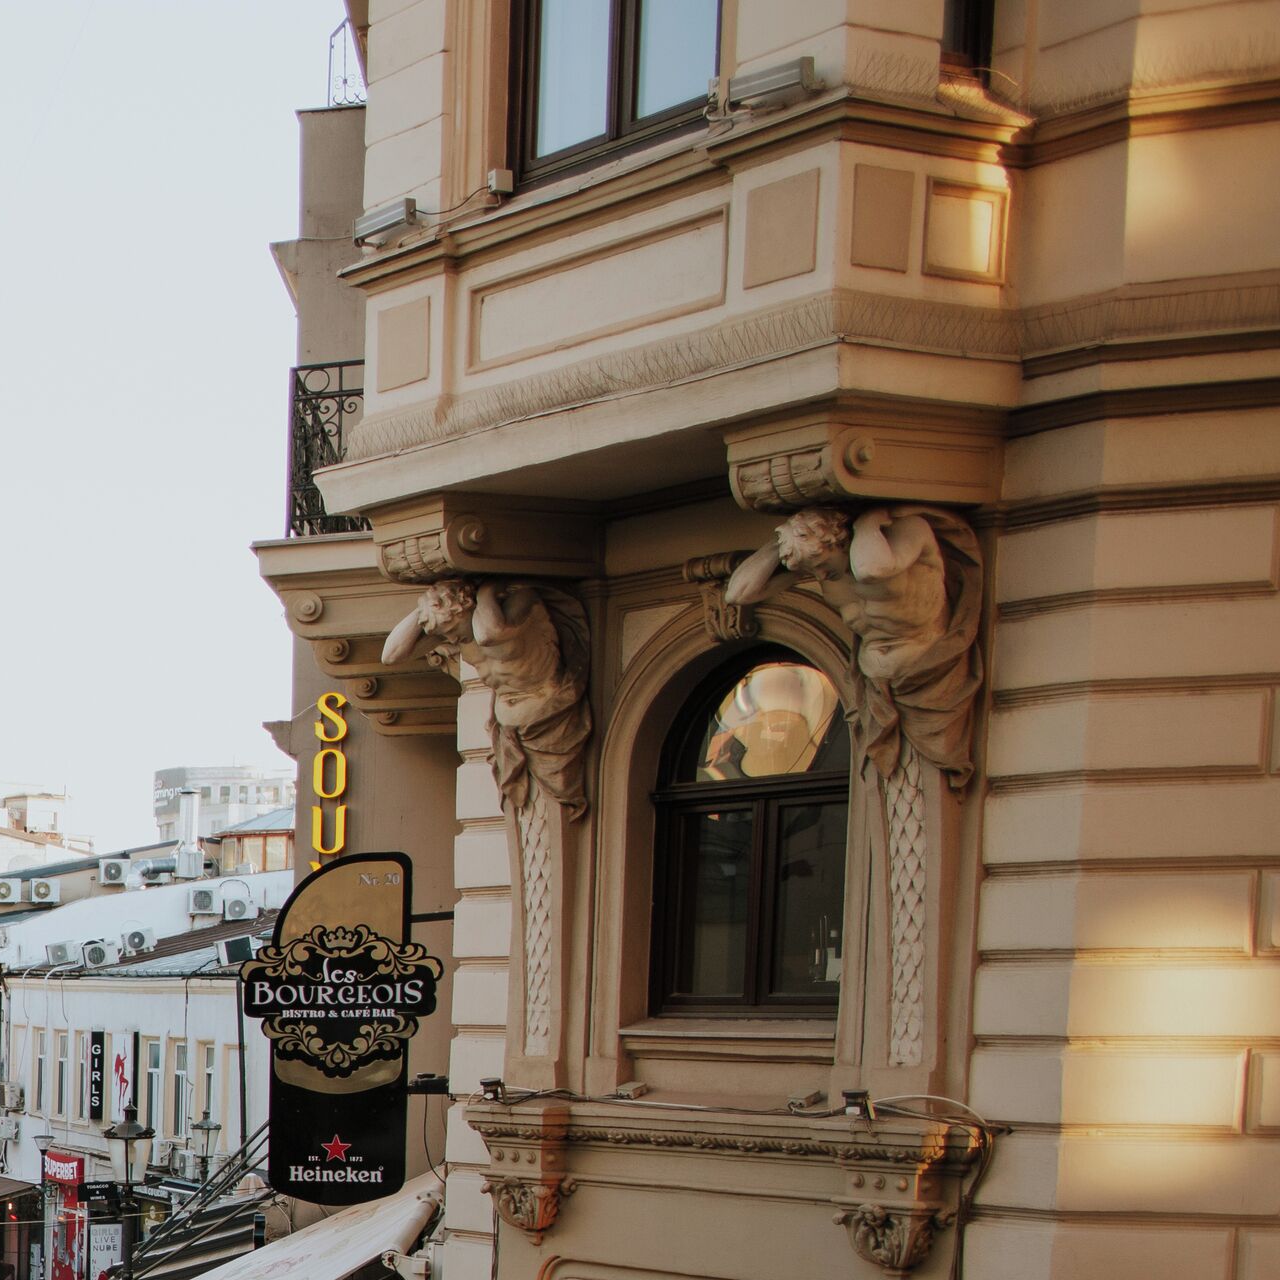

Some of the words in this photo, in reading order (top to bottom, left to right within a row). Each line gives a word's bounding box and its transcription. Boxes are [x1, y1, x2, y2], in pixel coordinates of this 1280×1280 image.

[309, 691, 349, 872] SOU
[385, 874, 400, 885] 20
[323, 958, 357, 984] les
[252, 980, 424, 1005] BOURGEOIS
[282, 1009, 326, 1019] BISTRO
[328, 1010, 338, 1018] &
[341, 1006, 370, 1018] CAFÉ
[372, 1008, 395, 1018] BAR
[91, 1044, 101, 1107] GIRLS
[45, 1155, 78, 1180] SUPERBET
[289, 1165, 383, 1183] Heineken
[93, 1244, 118, 1252] NUDE
[95, 1236, 116, 1244] LIVE
